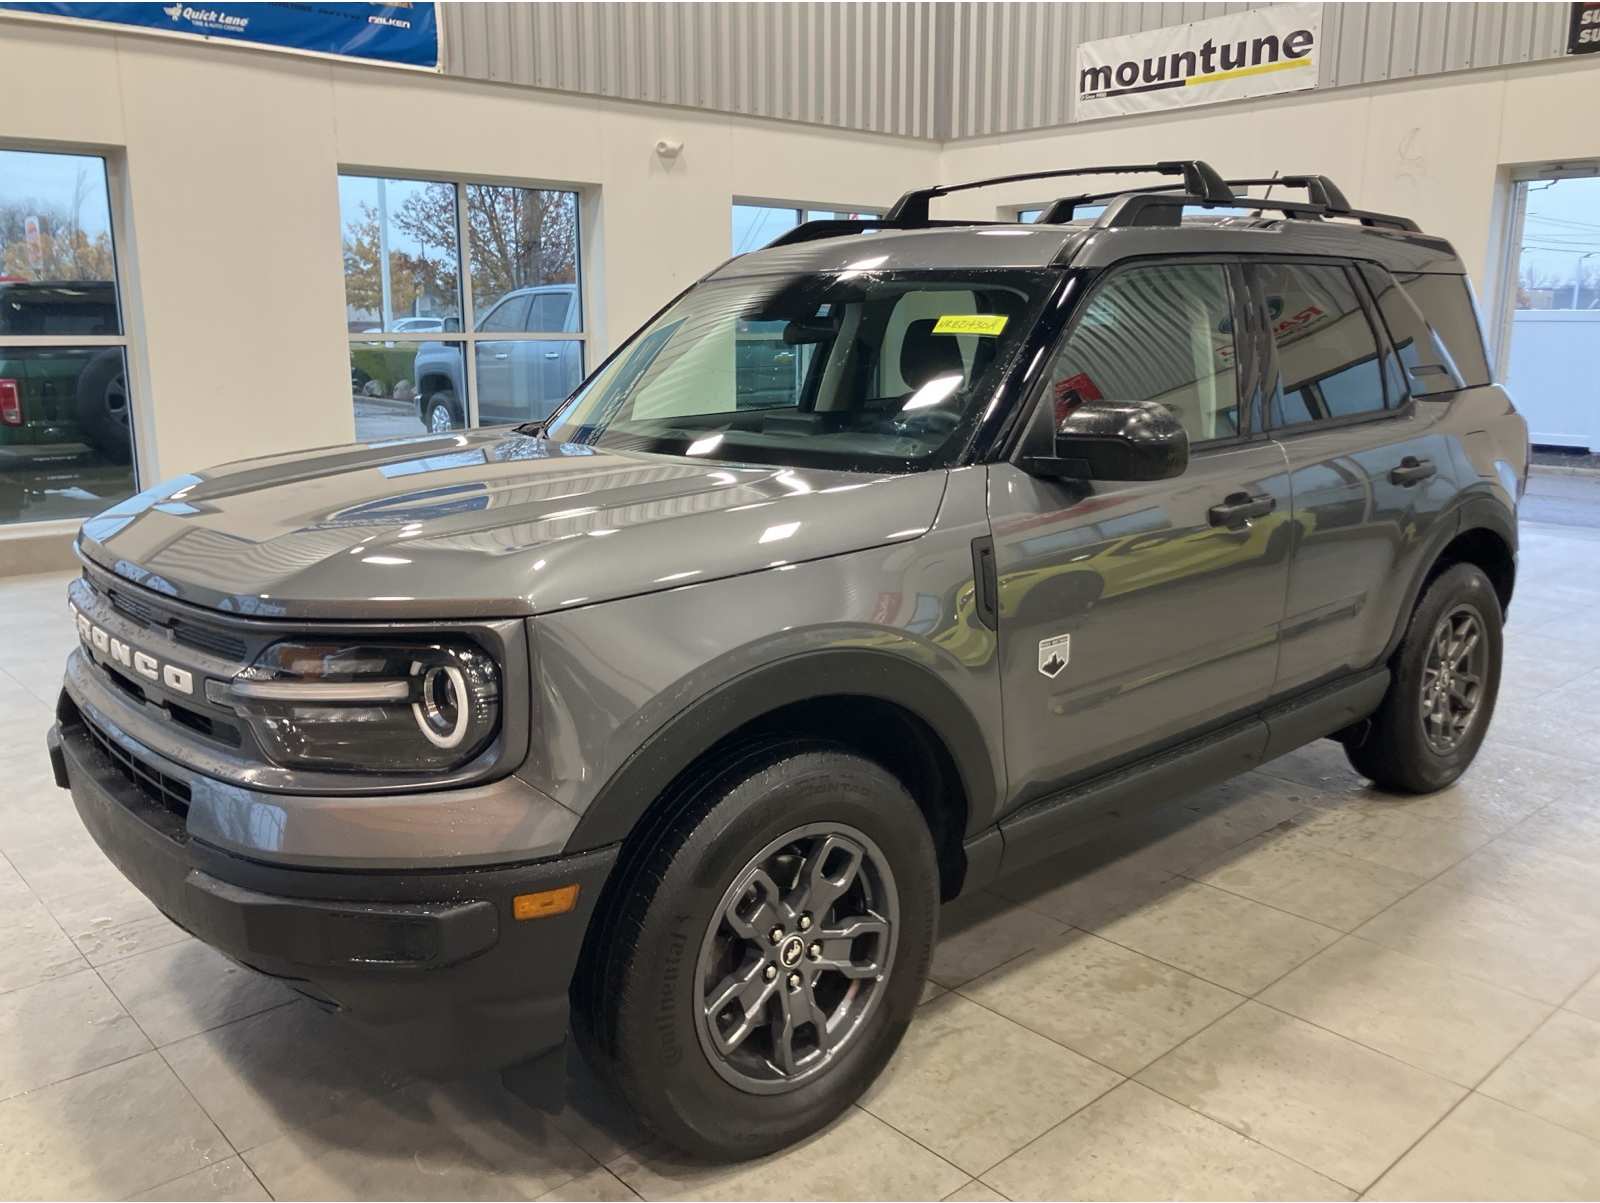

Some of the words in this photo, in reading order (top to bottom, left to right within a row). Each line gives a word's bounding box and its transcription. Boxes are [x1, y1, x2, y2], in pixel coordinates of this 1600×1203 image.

[183, 7, 218, 22] Quick
[218, 12, 248, 27] Lane
[368, 15, 411, 29] FALKEN
[1080, 28, 1314, 93] mountune
[68, 600, 194, 695] RONCO
